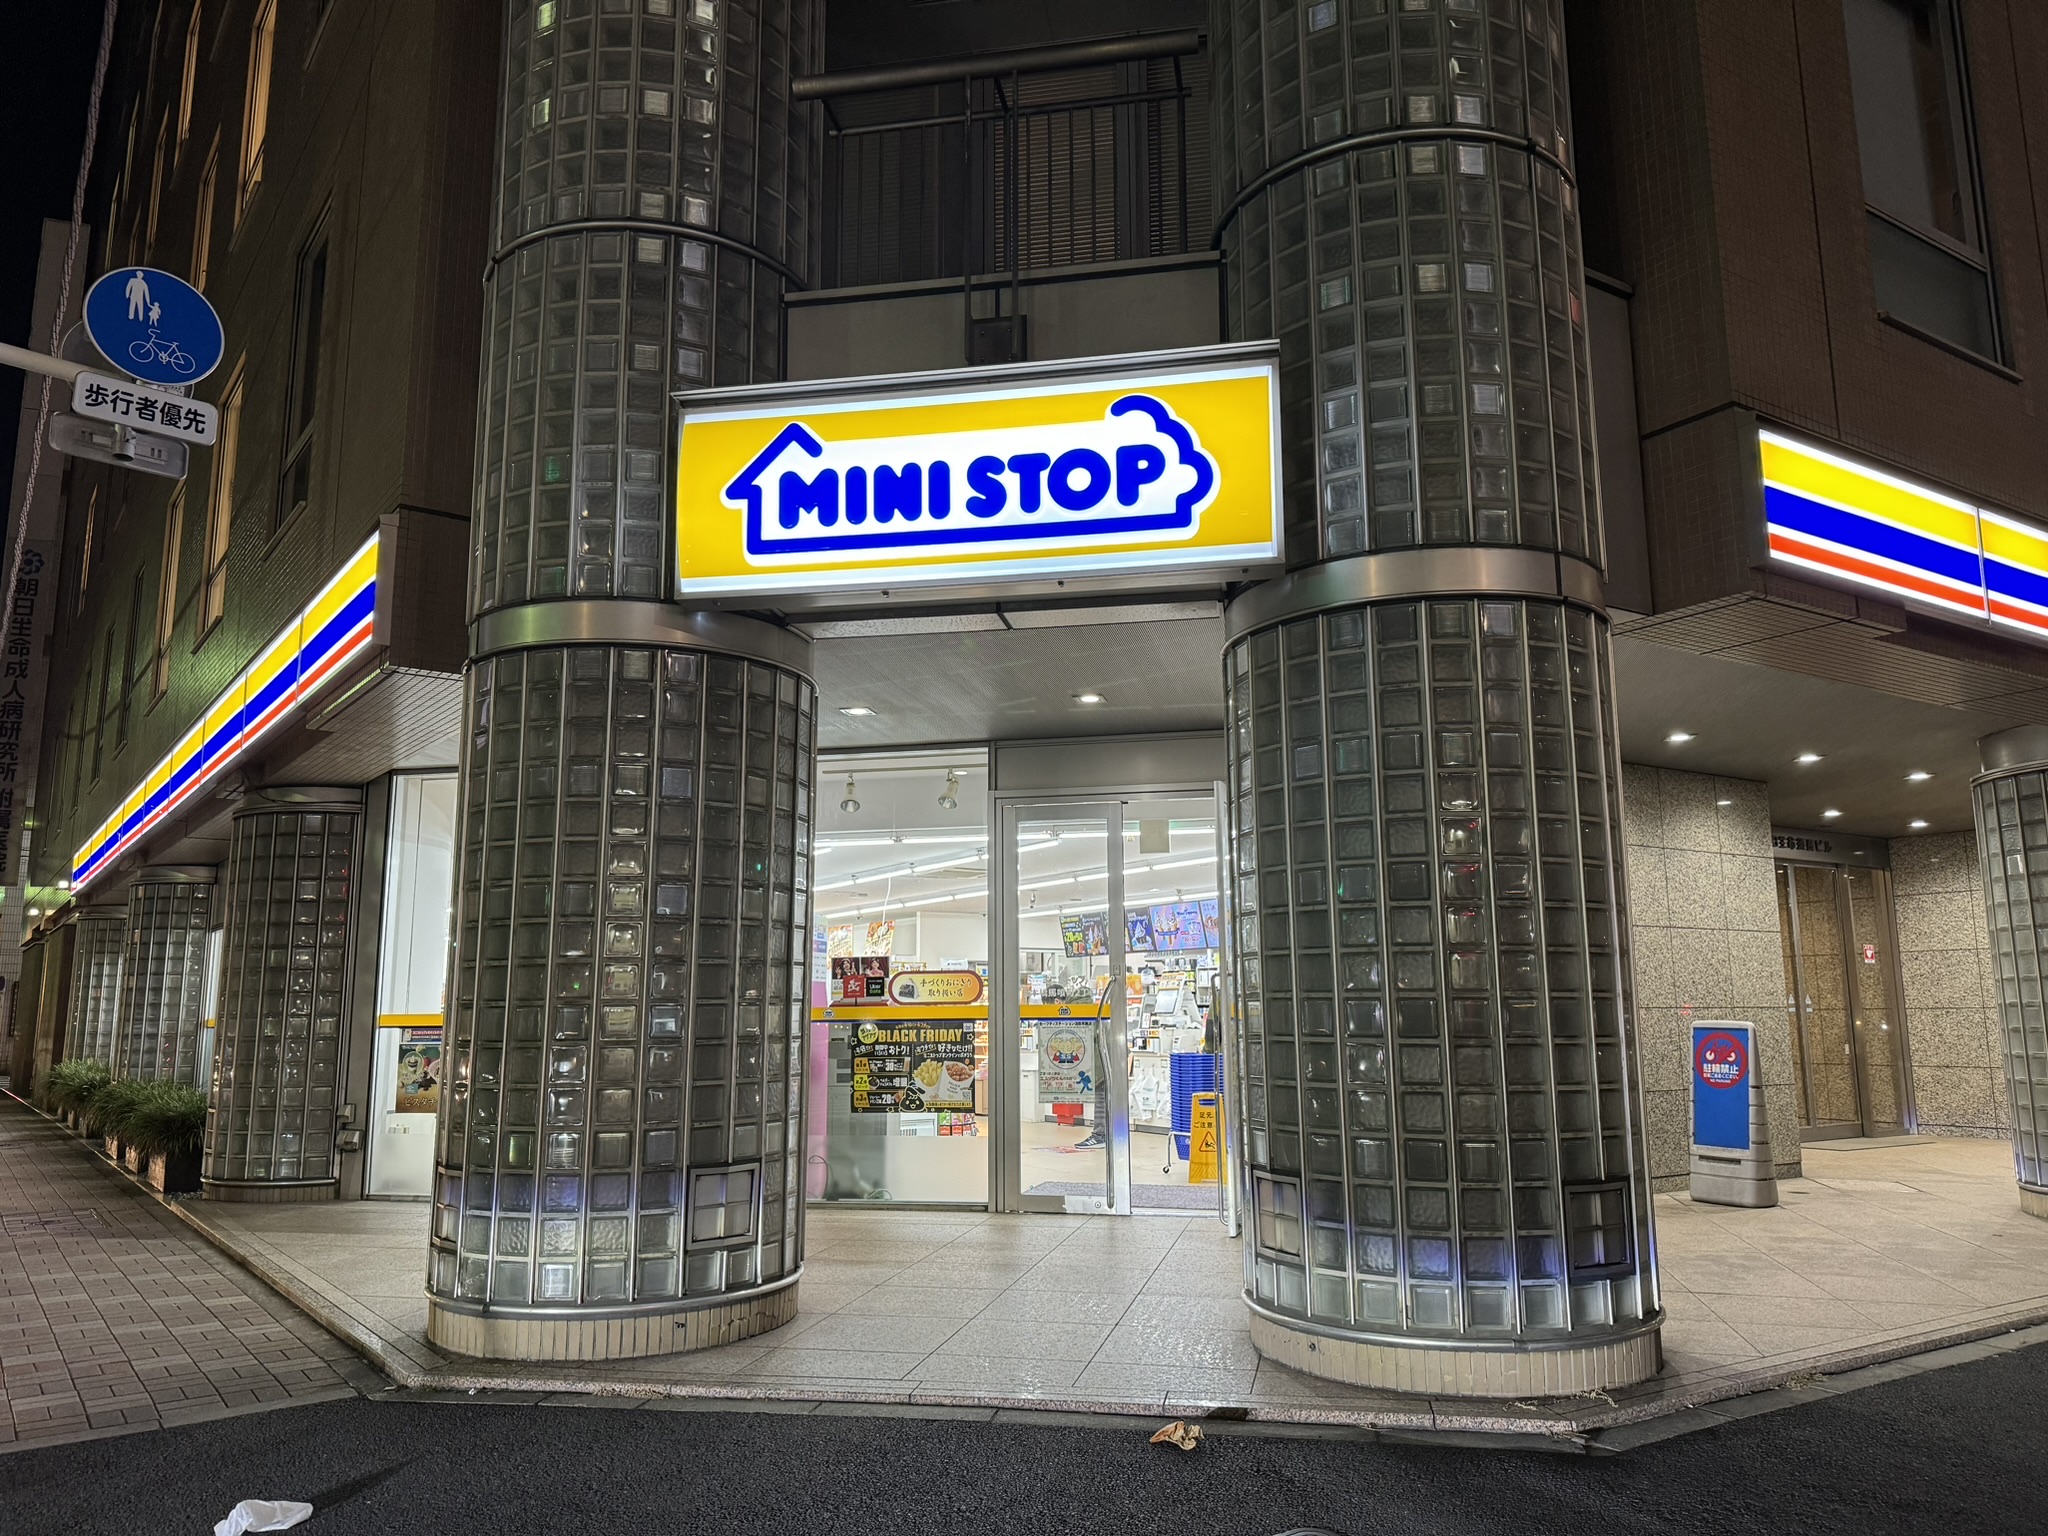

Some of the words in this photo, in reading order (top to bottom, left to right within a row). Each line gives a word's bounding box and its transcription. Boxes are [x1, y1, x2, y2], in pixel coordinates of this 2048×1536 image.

[85, 383, 207, 435] 歩行者優先
[778, 460, 951, 530] MINI
[965, 443, 1167, 519] STOP
[920, 977, 973, 988] 手づくりおにぎり
[927, 988, 964, 998] 取り扱い店
[878, 1030, 917, 1042] BLACK
[920, 1029, 962, 1042] FRIDAY
[1703, 1063, 1739, 1074] 駐輪禁止
